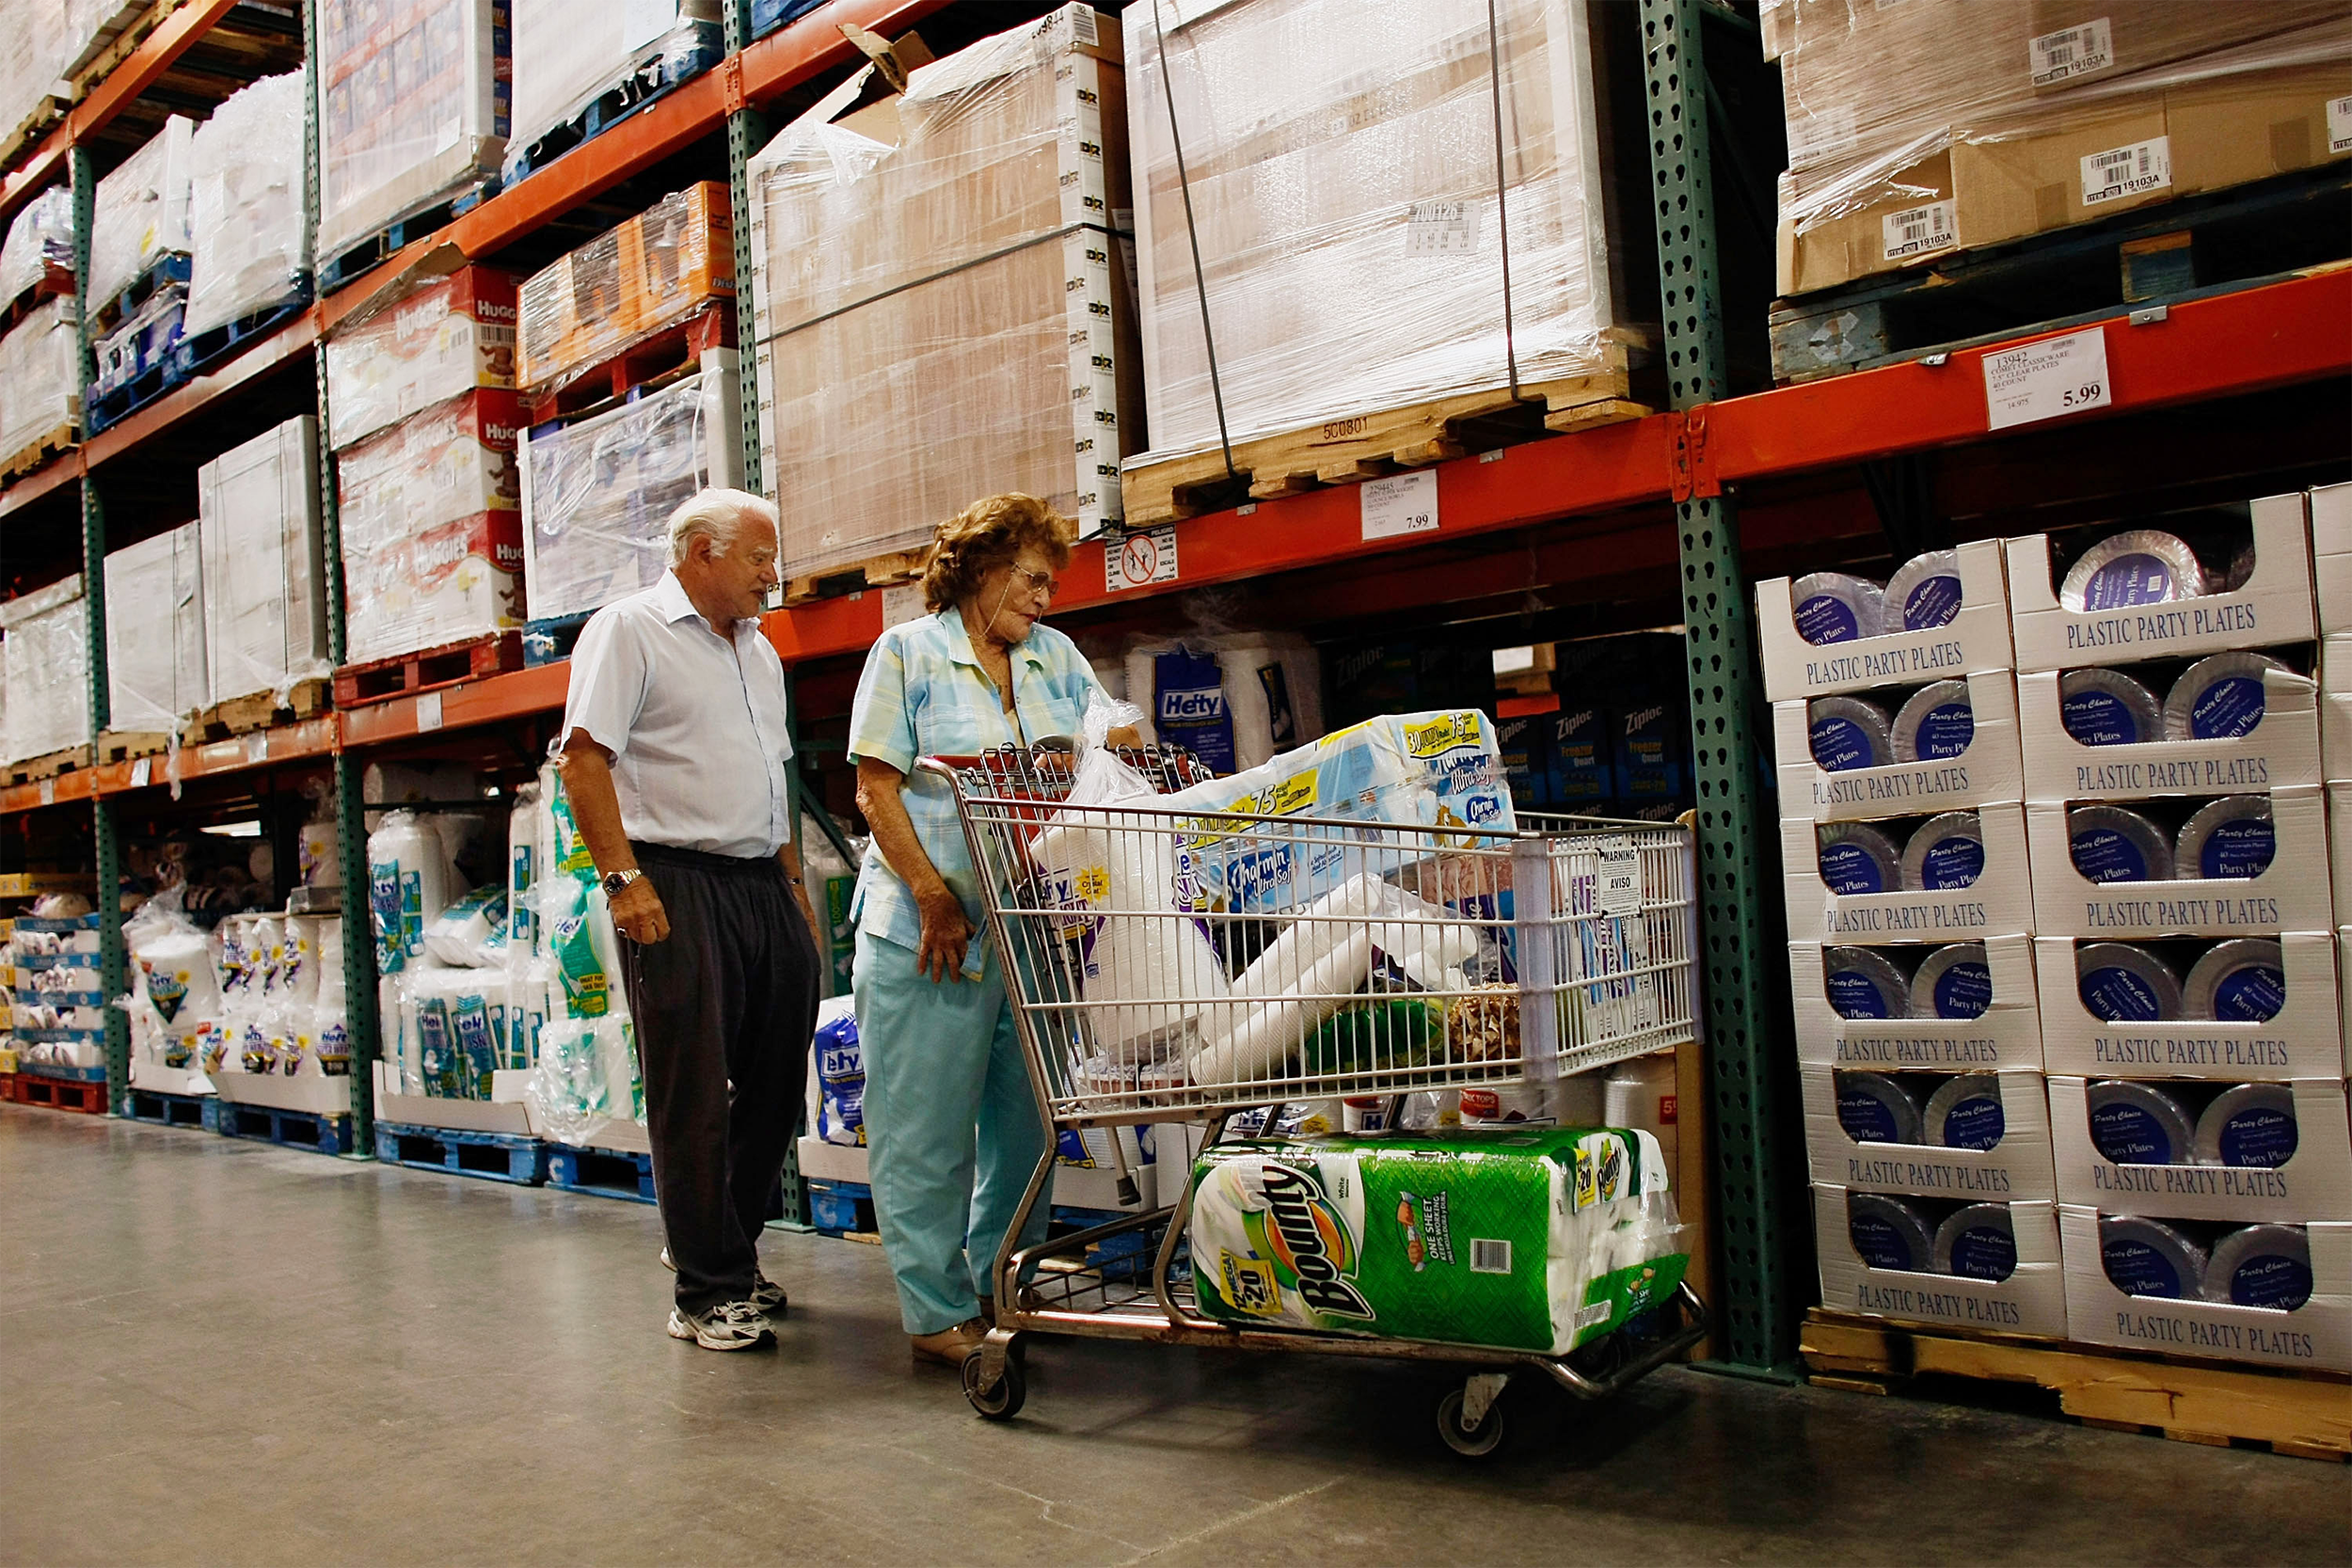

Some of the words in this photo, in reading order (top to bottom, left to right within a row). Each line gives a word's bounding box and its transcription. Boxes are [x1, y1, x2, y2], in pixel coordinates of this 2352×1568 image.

[2071, 55, 2106, 70] 19103A
[2089, 193, 2104, 202] ITEM
[2123, 175, 2159, 189] 19103A
[1919, 233, 1951, 246] 19103A
[478, 300, 516, 320] HUGG
[1996, 352, 2027, 368] 13942
[2007, 369, 2030, 378] CLEAR
[2032, 361, 2059, 372] PLATES
[2002, 376, 2026, 387] COUNT
[2063, 384, 2100, 406] 5.99
[1406, 515, 1428, 529] 7.99
[2094, 571, 2105, 589] Choice
[2127, 565, 2139, 585] Plates
[1813, 598, 1833, 612] Choice
[1905, 598, 1920, 618] Party
[1919, 579, 1936, 600] Choice
[1823, 626, 1846, 641] Plates
[2067, 619, 2131, 649] PLASTIC
[2137, 612, 2187, 641] PARTY
[2195, 604, 2255, 634] PLATES
[1807, 657, 1860, 685] PLASTIC
[1865, 650, 1906, 677] PARTY
[1912, 641, 1963, 671] PLATES
[1166, 694, 1218, 716] Hefty
[2088, 699, 2113, 708] Choice
[2194, 700, 2216, 720] Party
[2214, 681, 2236, 703] Choice
[1625, 706, 1662, 735] Ziploc
[1930, 712, 1950, 721] Party
[1556, 710, 1592, 740] Ziploc
[1826, 721, 1846, 735] Choice
[1408, 730, 1422, 753] 30
[1448, 713, 1465, 738] 75
[2093, 733, 2121, 743] Plates
[1562, 745, 1593, 757] Freezer
[1629, 742, 1662, 752] Freezer
[1931, 744, 1954, 755] Party
[1574, 756, 1595, 767] Quart
[1642, 753, 1662, 764] Quart
[1837, 751, 1859, 765] Plates
[1452, 768, 1475, 795] Ultra
[2077, 764, 2141, 791] PLASTIC
[2148, 761, 2199, 788] PARTY
[2206, 758, 2268, 785] PLATES
[1813, 779, 1864, 804] PLASTIC
[1867, 774, 1910, 800] PARTY
[1917, 768, 1968, 794] PLATES
[1250, 784, 1277, 815] 75
[2093, 834, 2117, 846] Choice
[2244, 829, 2273, 837] Choice
[1604, 849, 1635, 863] WARNING
[1839, 850, 1860, 860] Choice
[1931, 848, 1952, 858] Party
[1952, 843, 1974, 853] Choice
[2104, 867, 2131, 879] Plates
[2219, 863, 2245, 876] Party
[1611, 877, 1630, 889] AVISO
[1845, 880, 1868, 892] Plates
[1938, 879, 1960, 890] Party
[1827, 909, 1881, 932] PLASTIC
[1885, 906, 1928, 930] PARTY
[1934, 903, 1986, 928] PLATES
[2087, 902, 2152, 927] PLASTIC
[2158, 900, 2209, 926] PARTY
[2216, 898, 2279, 924] PLATES
[1952, 967, 1974, 976] Party
[2117, 971, 2136, 991] Party
[2134, 989, 2155, 1012] Choice
[1948, 996, 1970, 1011] Party
[2091, 990, 2111, 1012] Party
[2232, 992, 2255, 1016] Party
[1850, 1009, 1873, 1019] Plates
[1837, 1039, 1890, 1061] PLASTIC
[1898, 1040, 1939, 1061] PARTY
[1946, 1039, 1996, 1061] PLATES
[2096, 1038, 2161, 1063] PLASTIC
[2167, 1039, 2217, 1064] PARTY
[2225, 1040, 2288, 1066] PLATES
[1476, 1094, 1495, 1104] TOPS
[1856, 1098, 1878, 1106] Choice
[1951, 1110, 1973, 1119] Party
[1973, 1104, 1995, 1116] Choice
[2094, 1115, 2116, 1123] Party
[2117, 1111, 2141, 1120] Choice
[2231, 1120, 2255, 1130] Party
[2257, 1116, 2283, 1126] Choice
[1861, 1129, 1884, 1138] Plates
[2127, 1144, 2154, 1153] Plates
[2241, 1154, 2266, 1164] Party
[1849, 1159, 1902, 1185] PLASTIC
[1908, 1164, 1951, 1188] PARTY
[1956, 1167, 2009, 1192] PLATES
[2094, 1164, 2159, 1193] PLASTIC
[2167, 1169, 2217, 1195] PARTY
[2219, 1172, 2287, 1197] PLATES
[1423, 1199, 1434, 1233] SHEET
[1433, 1196, 1441, 1235] WORKING
[1257, 1165, 1374, 1319] Bounty
[1965, 1231, 1987, 1243] Party
[1988, 1235, 2012, 1245] Choice
[1427, 1236, 1438, 1259] ONE
[1436, 1236, 1446, 1260] KEEPS
[2126, 1247, 2150, 1257] Choice
[2240, 1269, 2264, 1278] Party
[2265, 1260, 2291, 1274] Choice
[2137, 1280, 2165, 1291] Plates
[1232, 1292, 1247, 1309] 12
[1859, 1284, 1915, 1312] PLASTIC
[1919, 1292, 1961, 1317] PARTY
[1966, 1298, 2019, 1324] PLATES
[2117, 1312, 2184, 1343] PLASTIC
[2190, 1322, 2242, 1349] PARTY
[2249, 1328, 2312, 1358] PLATES
